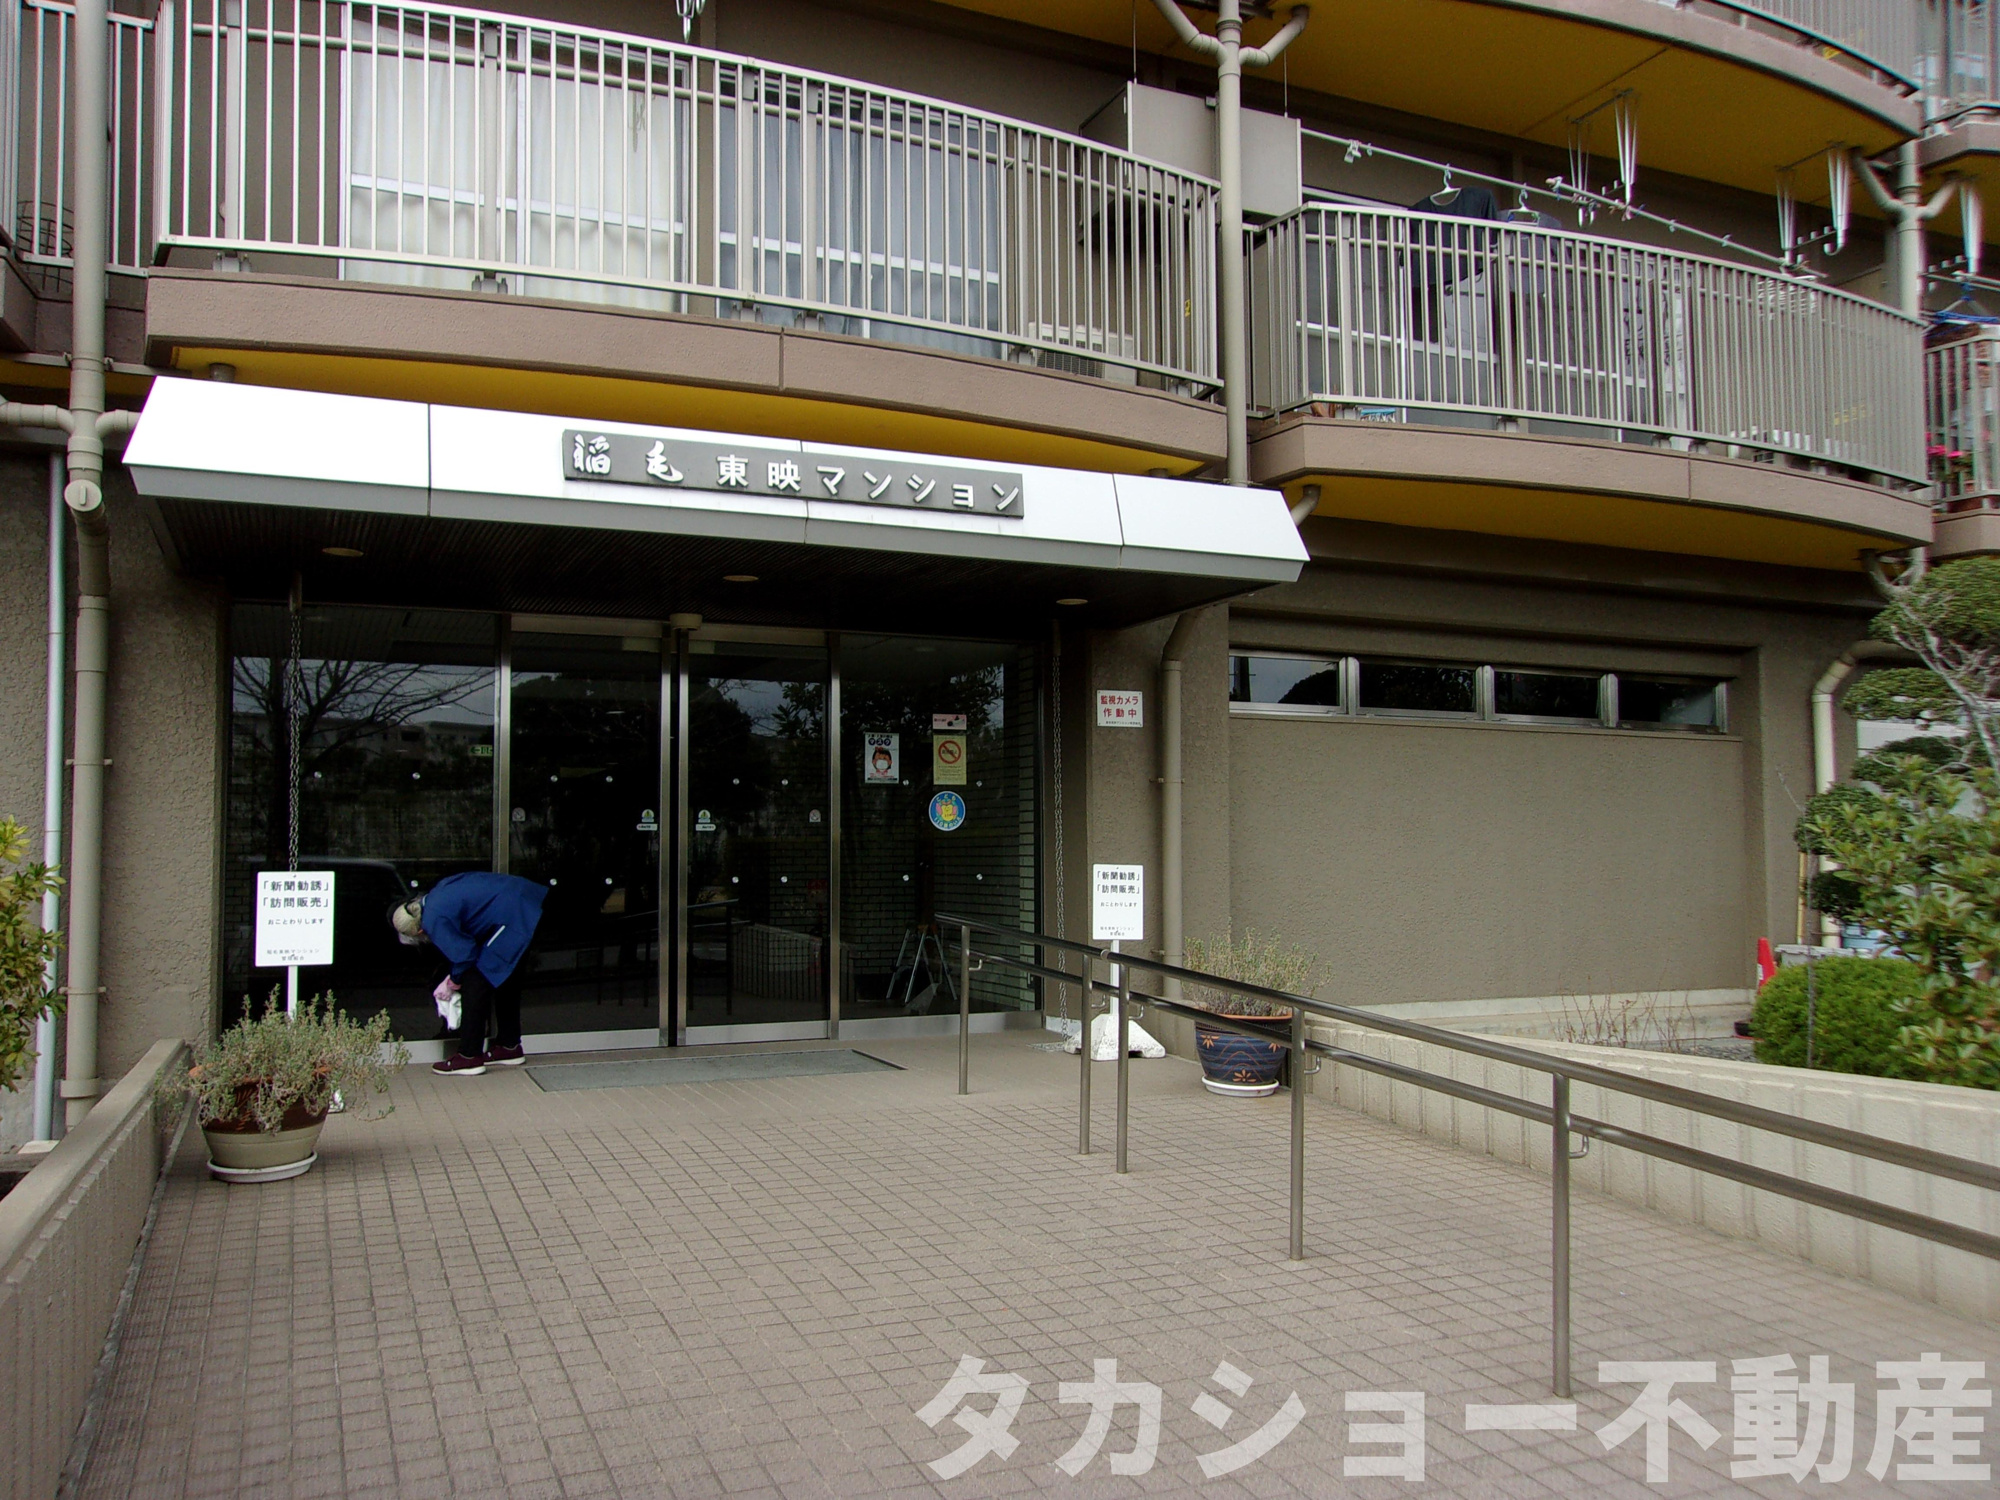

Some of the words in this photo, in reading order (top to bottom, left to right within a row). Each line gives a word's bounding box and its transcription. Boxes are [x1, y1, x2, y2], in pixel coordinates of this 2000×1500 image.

[1101, 695, 1139, 705] 監視カメラ
[1103, 707, 1137, 718] 作動中
[1097, 871, 1140, 881] 「新聞勧誘」
[263, 881, 329, 892] 「新聞勧誘」
[1097, 884, 1140, 894] 「訪問販売」
[263, 897, 329, 908] 「訪問販売」
